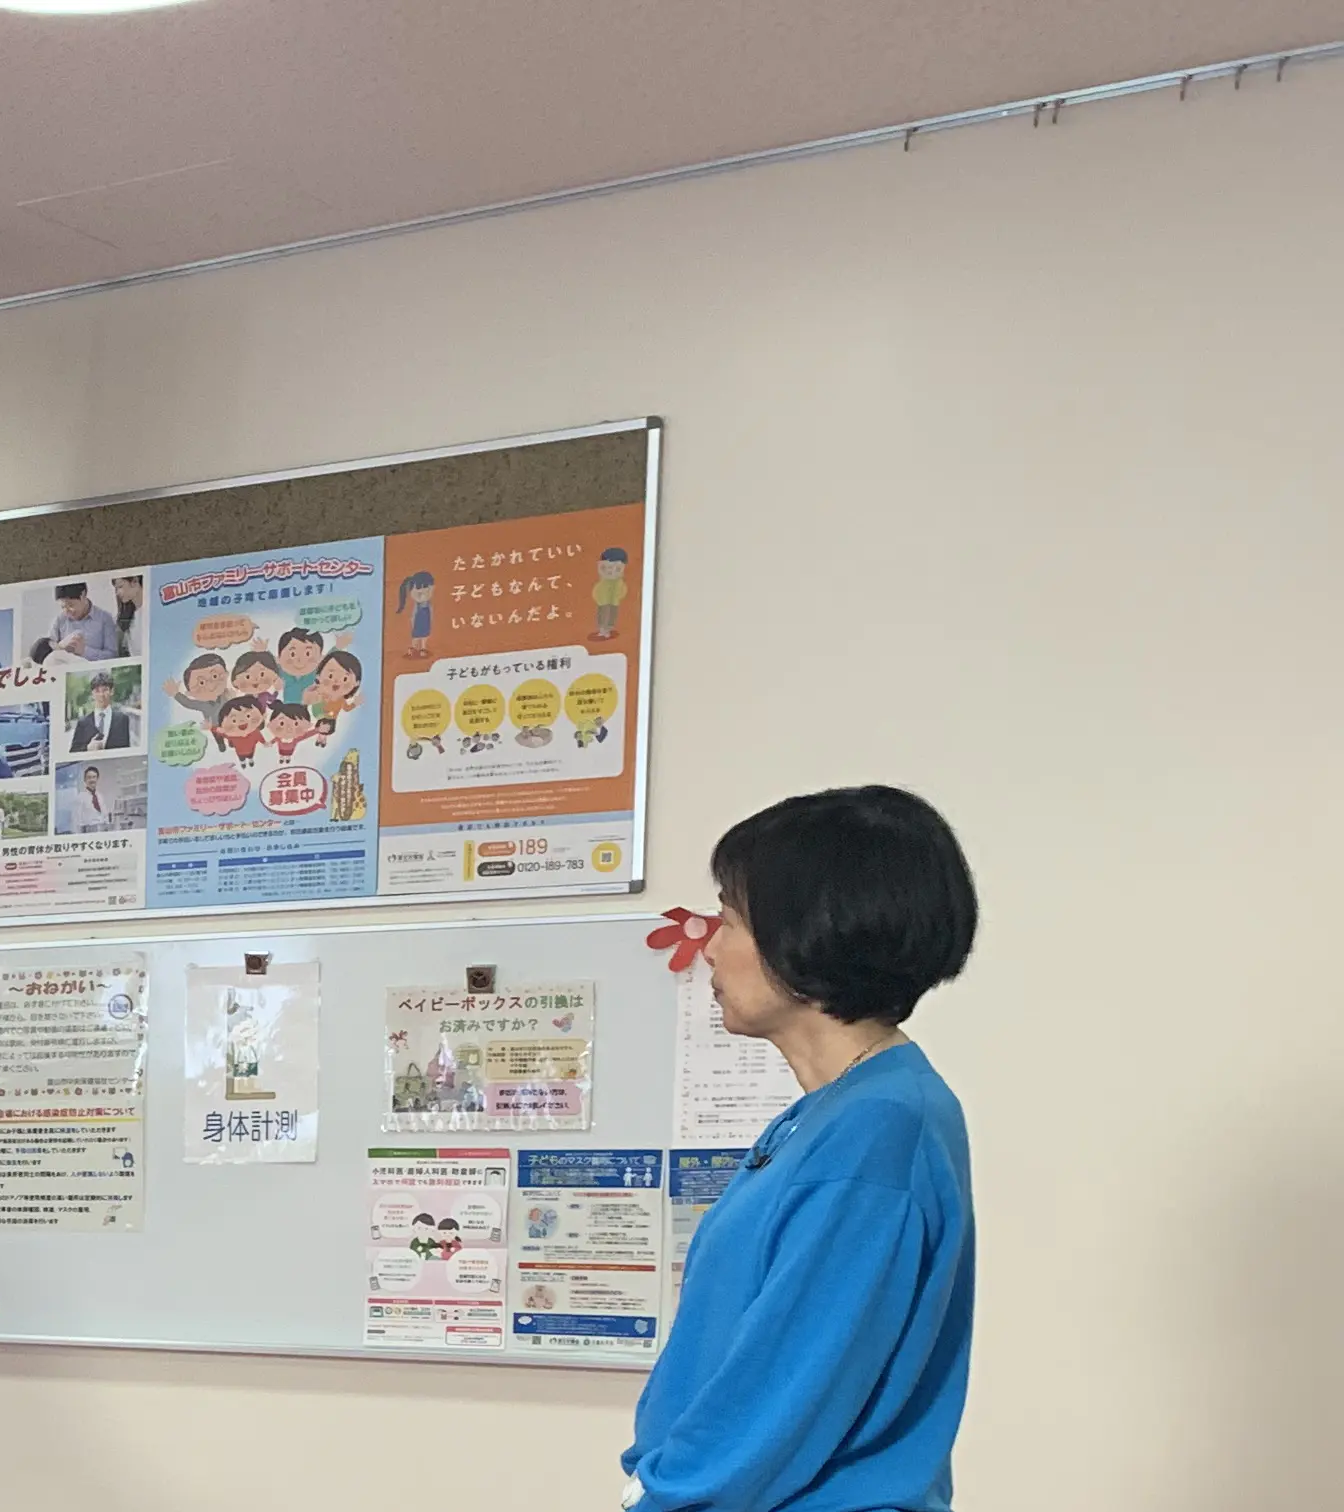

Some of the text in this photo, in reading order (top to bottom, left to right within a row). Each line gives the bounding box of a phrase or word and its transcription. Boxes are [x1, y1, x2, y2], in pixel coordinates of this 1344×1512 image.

[452, 543, 583, 571] たたかれていい
[450, 574, 574, 602] 子どもなんて、
[451, 604, 574, 629] いないんだよ。
[446, 656, 572, 680] 子どもがもっている権利
[277, 770, 308, 788] 会員
[268, 788, 316, 807] 募集中
[518, 838, 548, 856] 189
[516, 859, 585, 873] 0120-189-783
[203, 1108, 299, 1143] 身体計測
